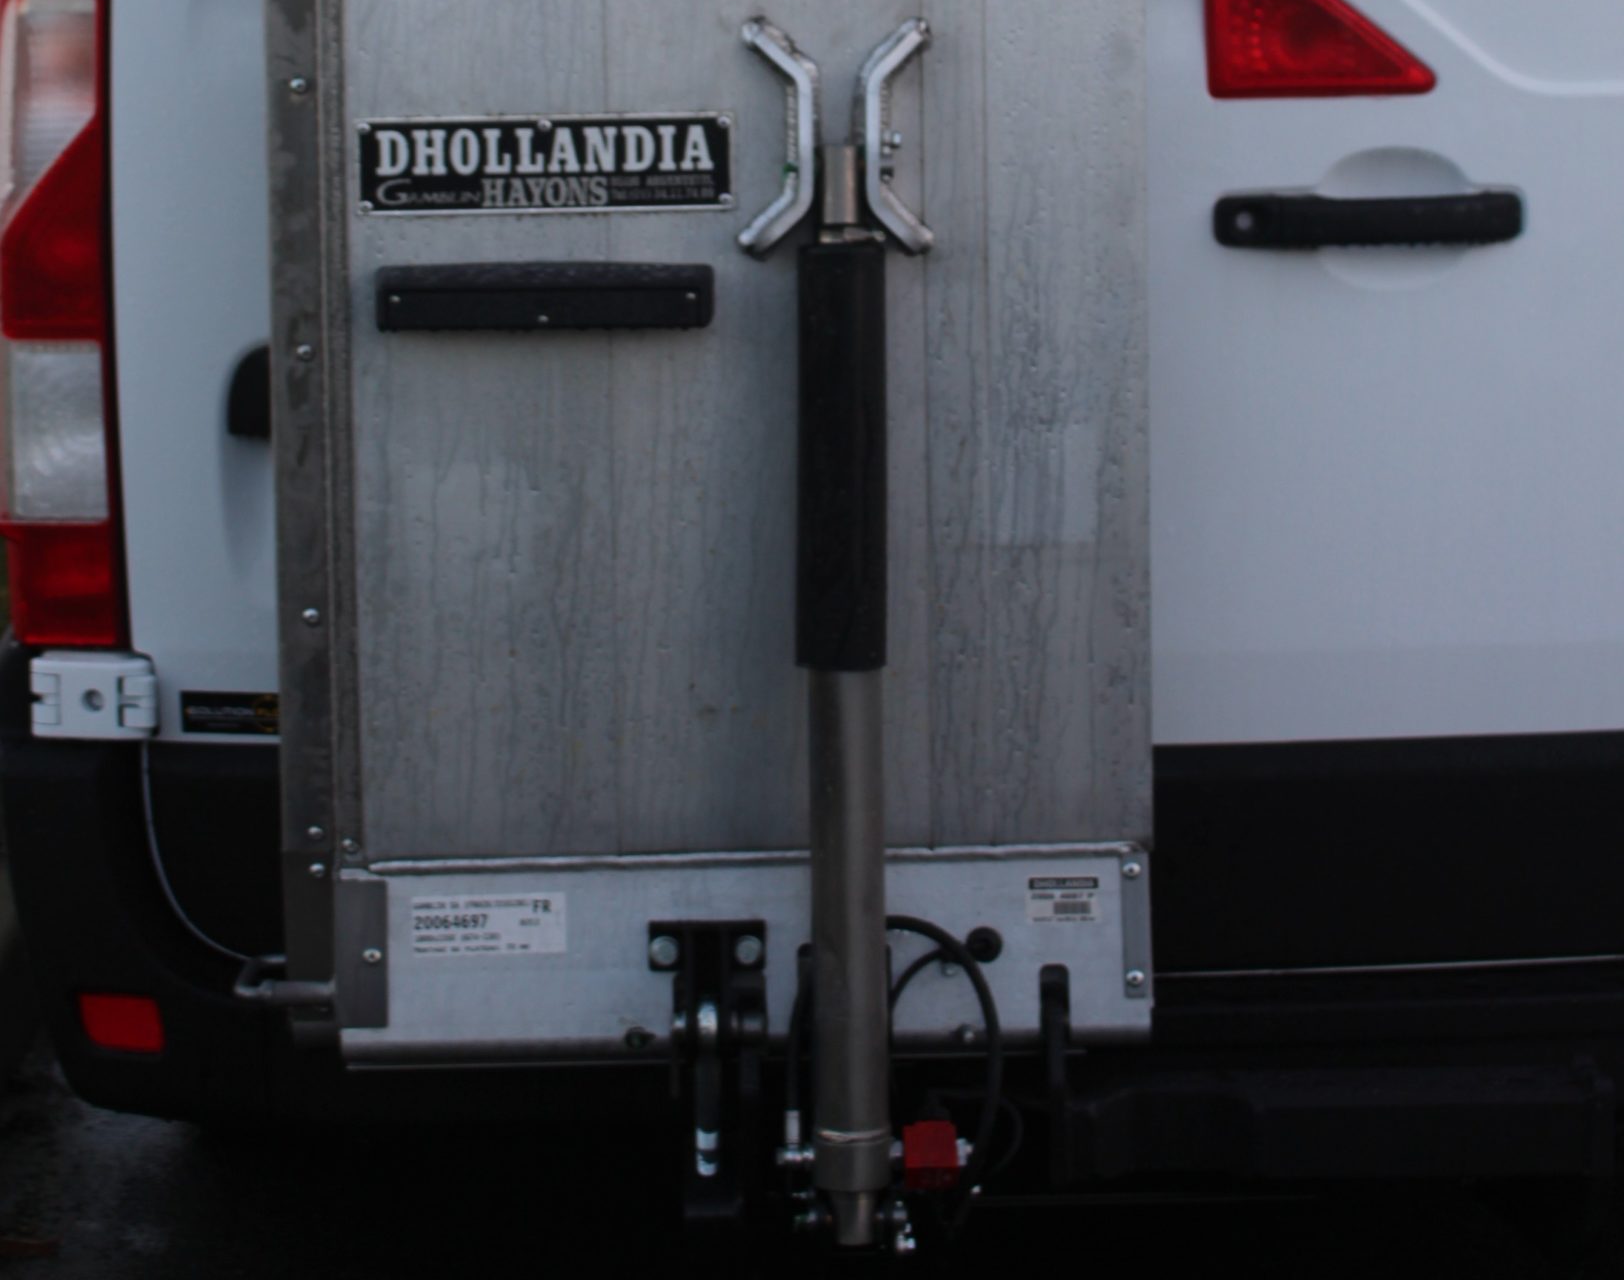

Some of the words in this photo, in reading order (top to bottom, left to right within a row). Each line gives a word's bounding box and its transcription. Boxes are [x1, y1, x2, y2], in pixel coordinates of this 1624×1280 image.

[376, 124, 715, 176] DHOLLANDIA
[481, 175, 610, 208] HAYONS
[532, 898, 552, 913] FR
[414, 913, 488, 930] 20064697
